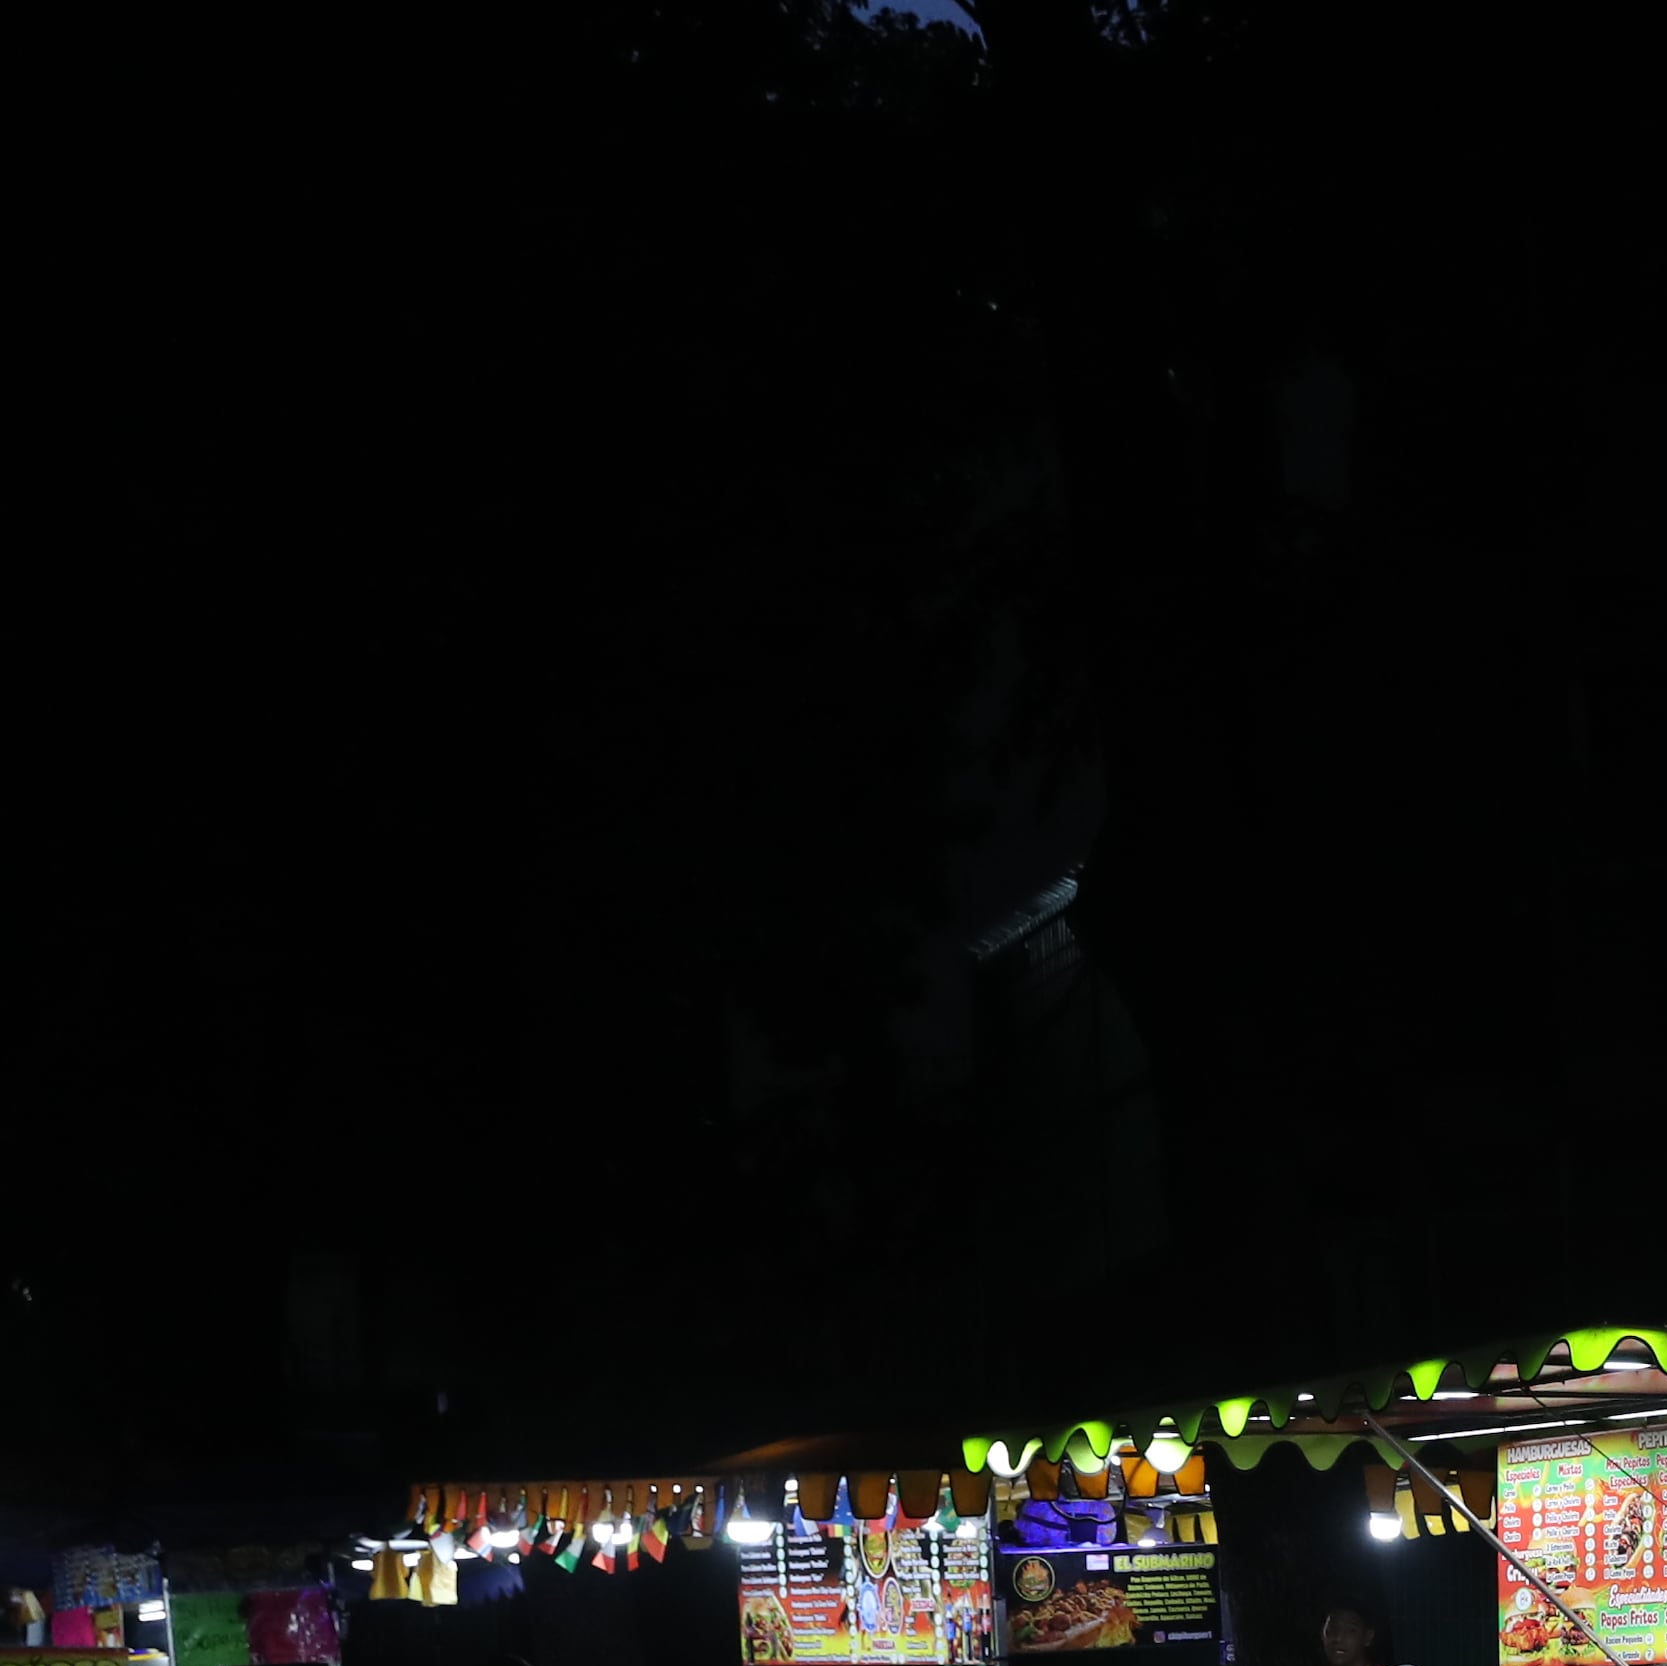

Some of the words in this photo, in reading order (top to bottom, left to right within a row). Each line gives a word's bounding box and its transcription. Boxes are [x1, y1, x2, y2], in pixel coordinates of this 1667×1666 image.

[1507, 1440, 1593, 1464] HAMBURGUESAS
[1113, 1555, 1132, 1573] EL
[1133, 1551, 1216, 1573] SUBMARINO
[1601, 1612, 1628, 1631] Papas
[1629, 1609, 1659, 1627] Fritas
